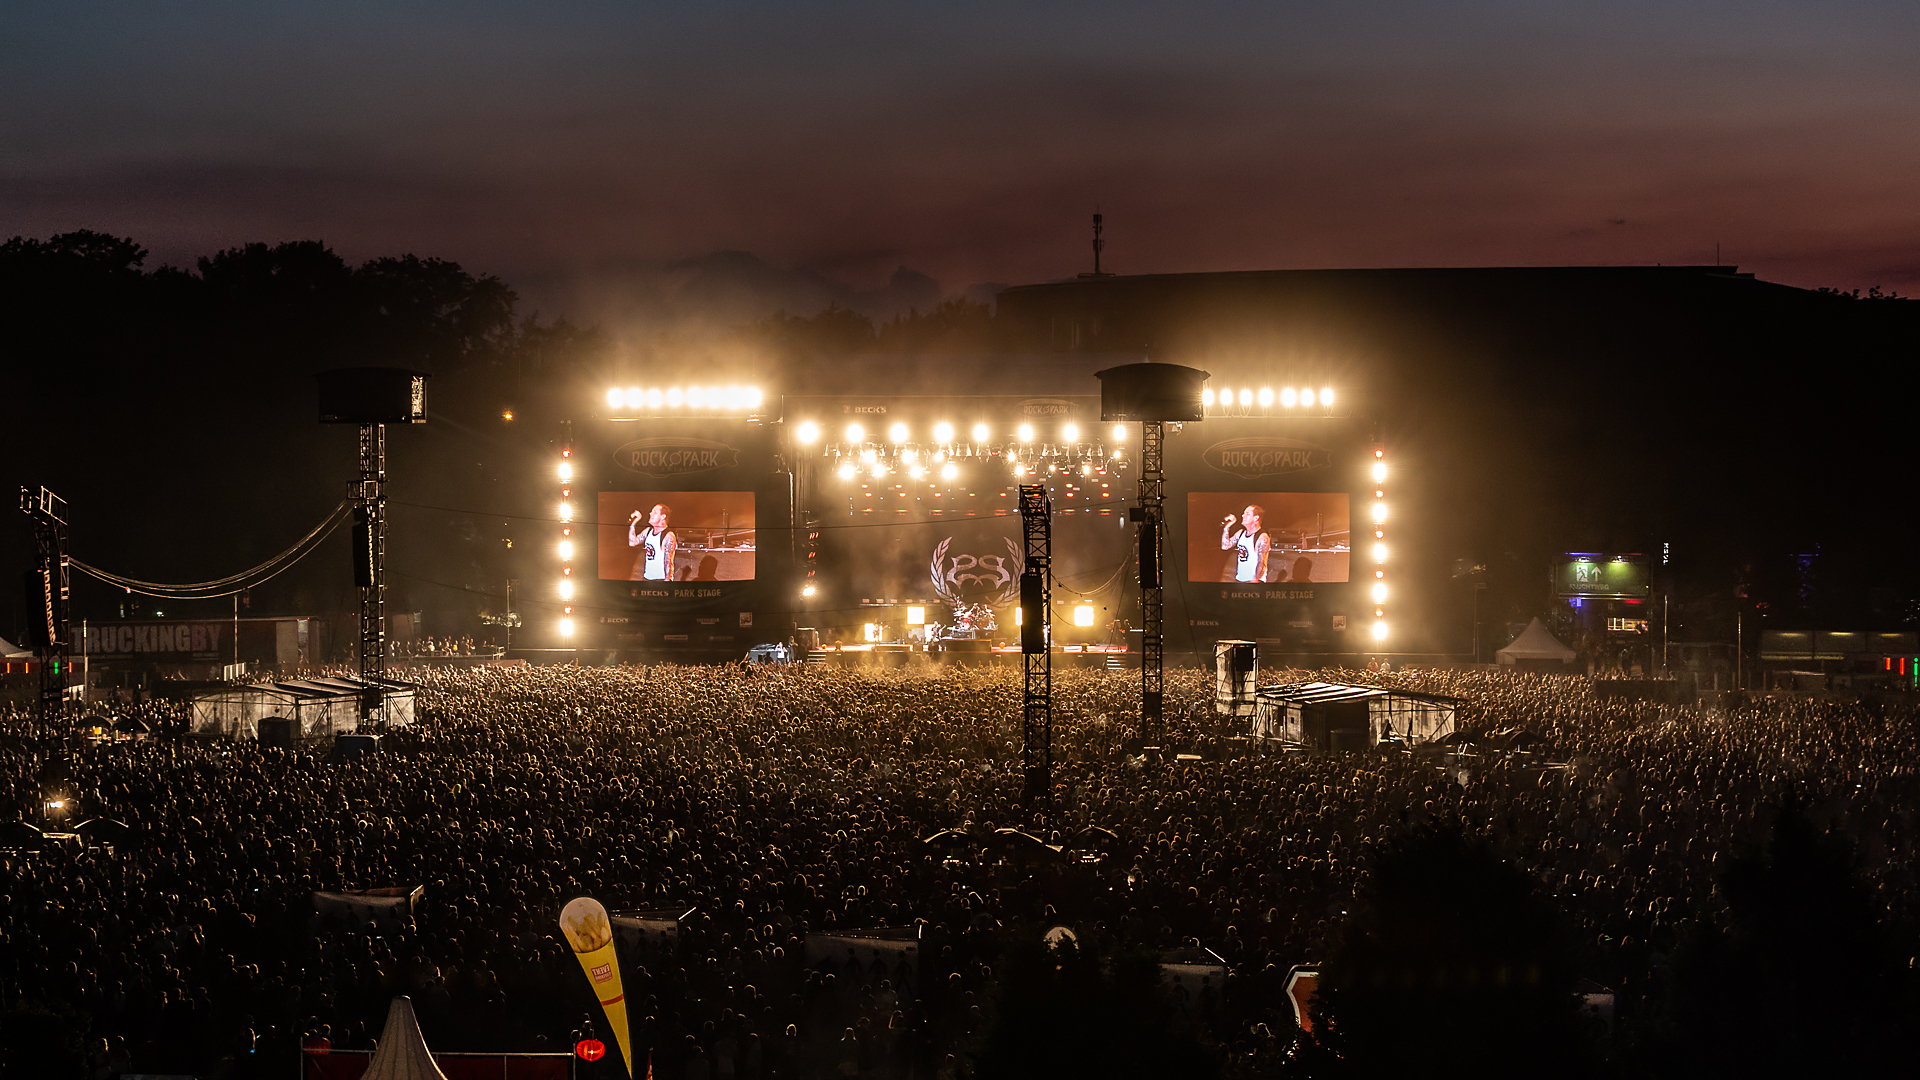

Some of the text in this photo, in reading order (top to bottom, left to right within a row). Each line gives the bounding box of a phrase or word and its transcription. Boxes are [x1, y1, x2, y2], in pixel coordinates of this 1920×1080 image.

[683, 451, 719, 467] PARK
[1274, 451, 1312, 467] PARK
[674, 589, 695, 598] PARK
[697, 589, 722, 597] STAGE
[1265, 590, 1287, 599] PARK
[1289, 590, 1314, 599] STAGE
